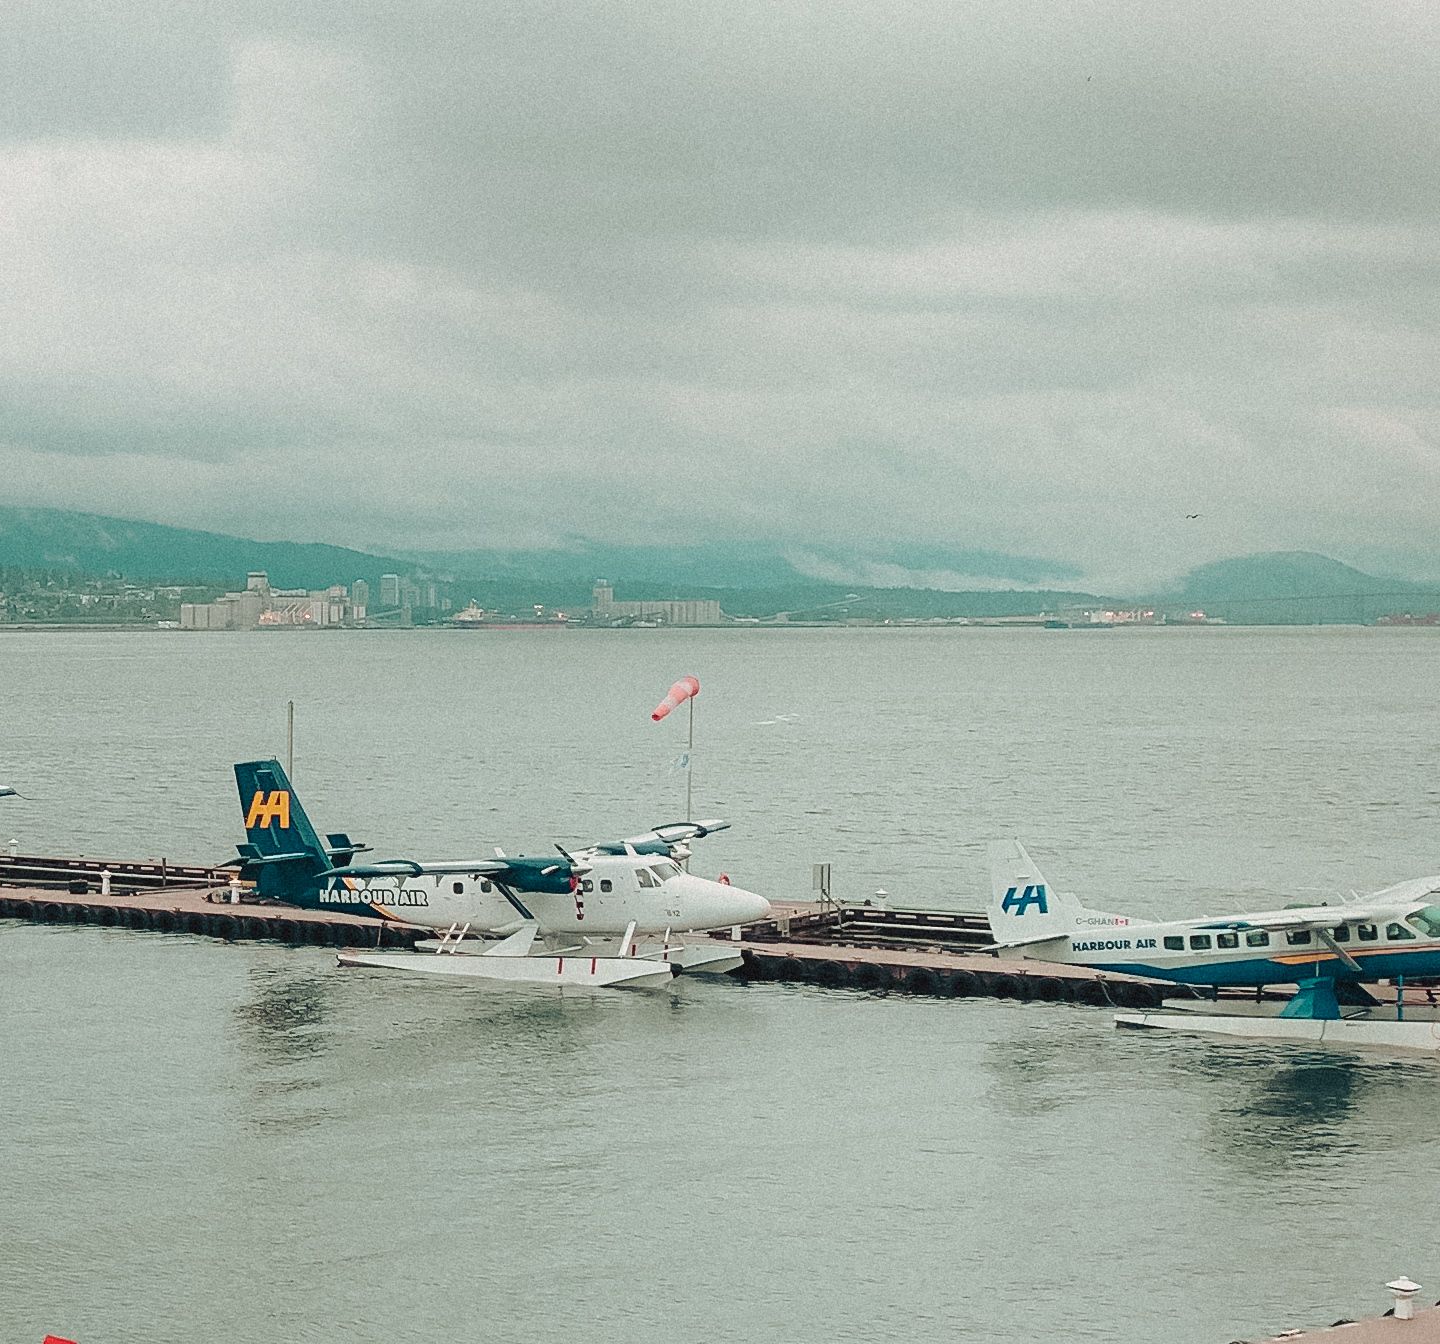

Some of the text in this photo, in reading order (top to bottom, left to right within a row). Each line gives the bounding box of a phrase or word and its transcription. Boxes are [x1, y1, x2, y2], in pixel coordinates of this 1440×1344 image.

[245, 791, 290, 829] HA
[319, 889, 429, 906] HARBOUR AIR
[1072, 938, 1157, 952] HARBOUR AIR
